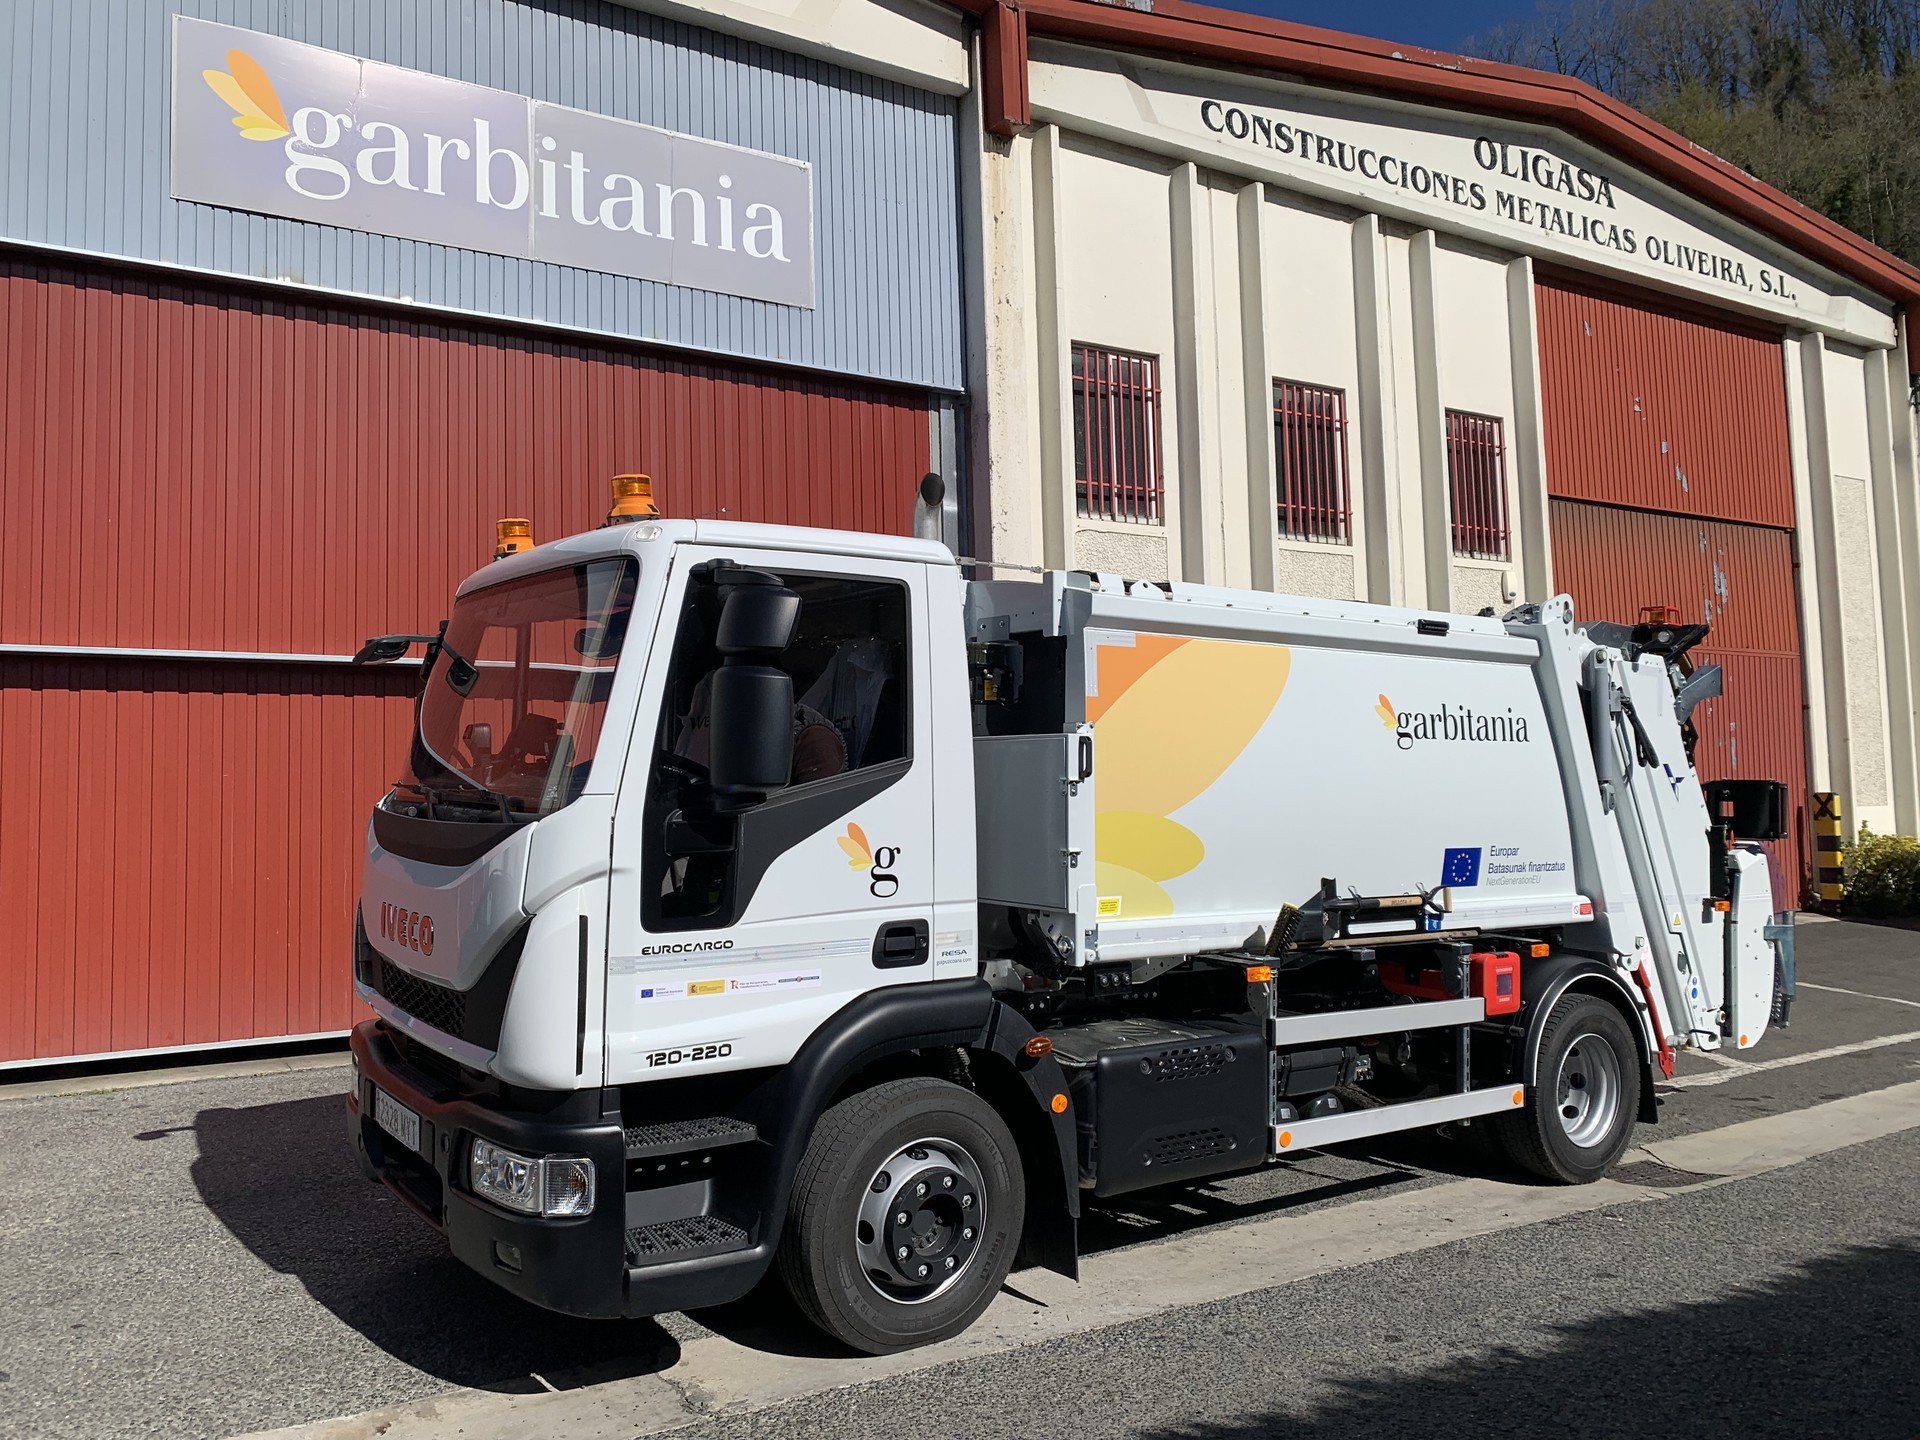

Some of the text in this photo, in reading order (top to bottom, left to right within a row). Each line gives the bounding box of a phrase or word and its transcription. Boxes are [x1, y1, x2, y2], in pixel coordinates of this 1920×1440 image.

[284, 106, 791, 263] garbitania
[1474, 136, 1617, 209] OLIGASA
[1200, 100, 1797, 300] CONSTRUCCIONES METALICAS OLIVEIRA, S.L.
[1396, 703, 1530, 750] garbitania
[1488, 860, 1566, 874] Batasunak finantzatua
[1490, 845, 1520, 858] Europar
[869, 846, 901, 898] g
[1486, 875, 1541, 886] NextGenerationEU
[381, 901, 434, 956] IVECO
[641, 940, 734, 956] EUROCARGO
[941, 949, 968, 957] RESA
[645, 1043, 733, 1068] 120-220
